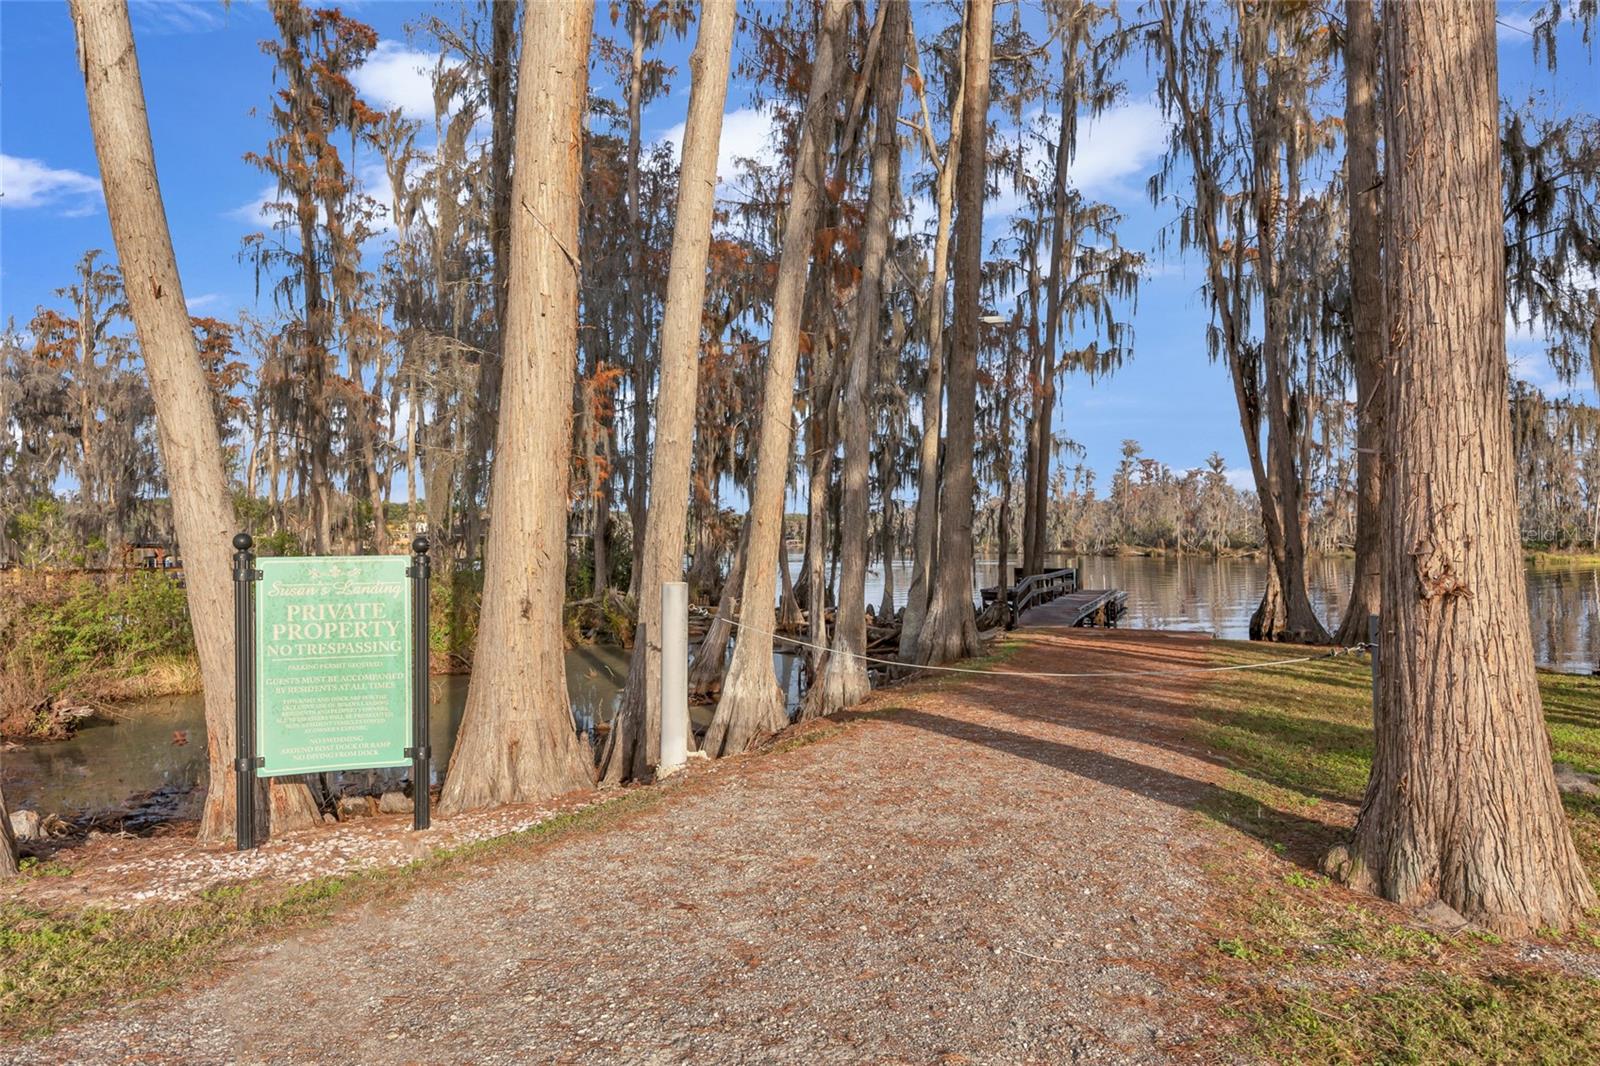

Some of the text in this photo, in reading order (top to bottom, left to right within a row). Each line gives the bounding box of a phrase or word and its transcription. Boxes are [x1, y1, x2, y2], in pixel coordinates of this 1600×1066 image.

[267, 580, 403, 598] Susan's Landing
[286, 602, 387, 622] PRIVATE
[271, 620, 402, 641] PROPERTY
[267, 640, 402, 657] NO TRESPASSING
[287, 663, 319, 671] PARKING
[319, 662, 346, 670] PERMIT
[265, 672, 405, 686] GUESTS MUST BE ACCOMPANIED
[275, 681, 396, 695] BY RESIDENTS AT ALL TIMES
[321, 735, 364, 744] SWIMMING
[281, 746, 314, 755] AROUND
[335, 743, 358, 751] DOCK
[358, 742, 369, 750] OR
[370, 741, 391, 749] RAMP
[306, 752, 332, 760] DIVING
[333, 750, 356, 759] FROM
[356, 749, 379, 757] DOCK
